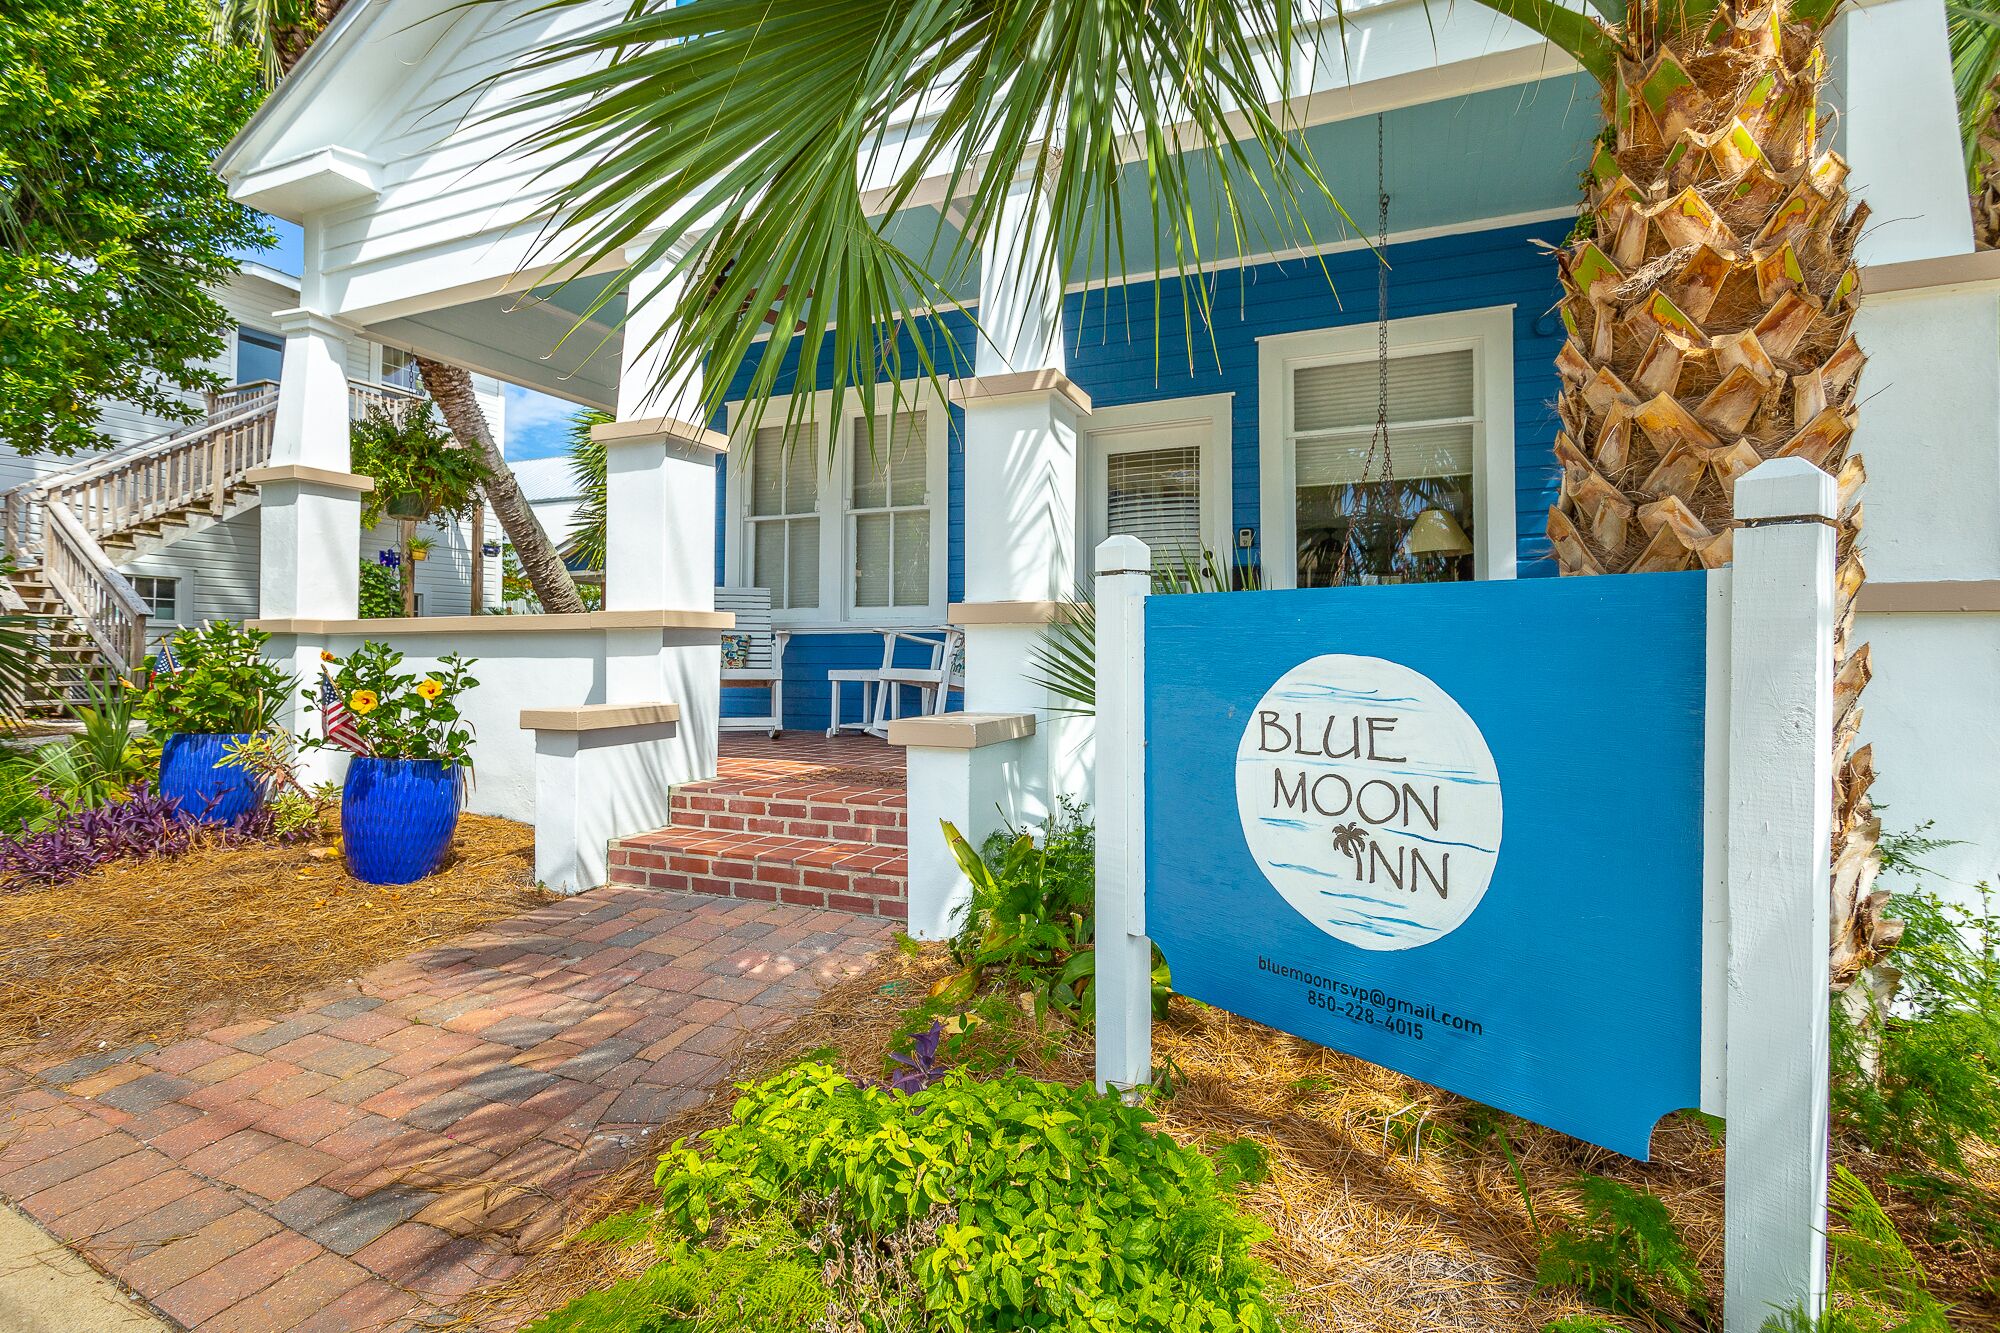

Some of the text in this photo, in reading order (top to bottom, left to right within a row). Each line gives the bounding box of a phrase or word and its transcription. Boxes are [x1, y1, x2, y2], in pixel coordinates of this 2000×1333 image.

[1258, 710, 1407, 763] BLUE
[1273, 767, 1440, 832] MOON
[1340, 826, 1449, 899] INN
[1257, 955, 1483, 1035] bluemoonrsvp@gmail.com
[1307, 990, 1425, 1041] 850-228-4015
